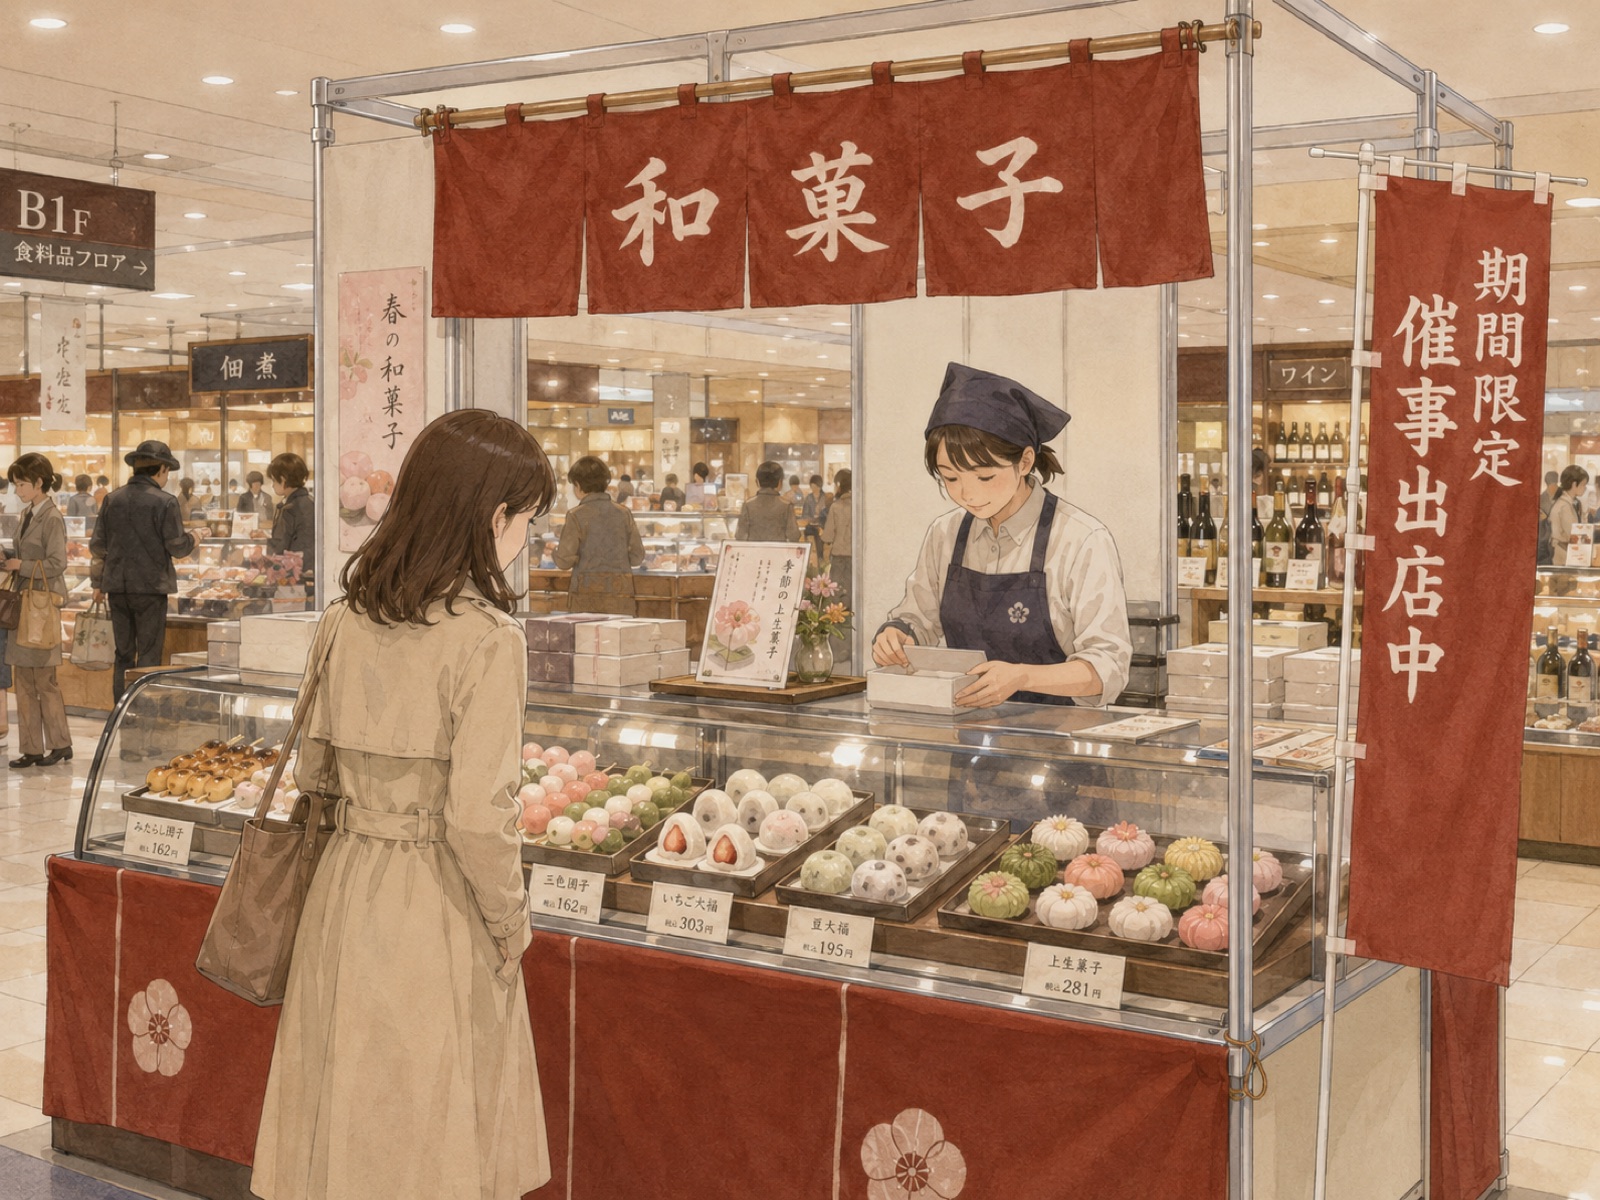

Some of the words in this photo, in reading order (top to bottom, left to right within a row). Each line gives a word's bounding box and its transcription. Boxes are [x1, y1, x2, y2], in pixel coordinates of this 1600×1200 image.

[17, 189, 92, 235] B1F
[611, 136, 1064, 267] 和菓子
[14, 240, 127, 272] 食料品フロア
[220, 351, 278, 381] 佃煮
[380, 292, 407, 450] 春の和菓子
[1281, 365, 1337, 385] ワイン
[1469, 246, 1529, 487] 期間限定
[1381, 293, 1461, 704] 催事出店中
[766, 558, 795, 660] 季節の上生菓子
[663, 893, 718, 913] いちご大福
[811, 917, 850, 936] 豆大福
[1047, 954, 1103, 975] 上生菓子
